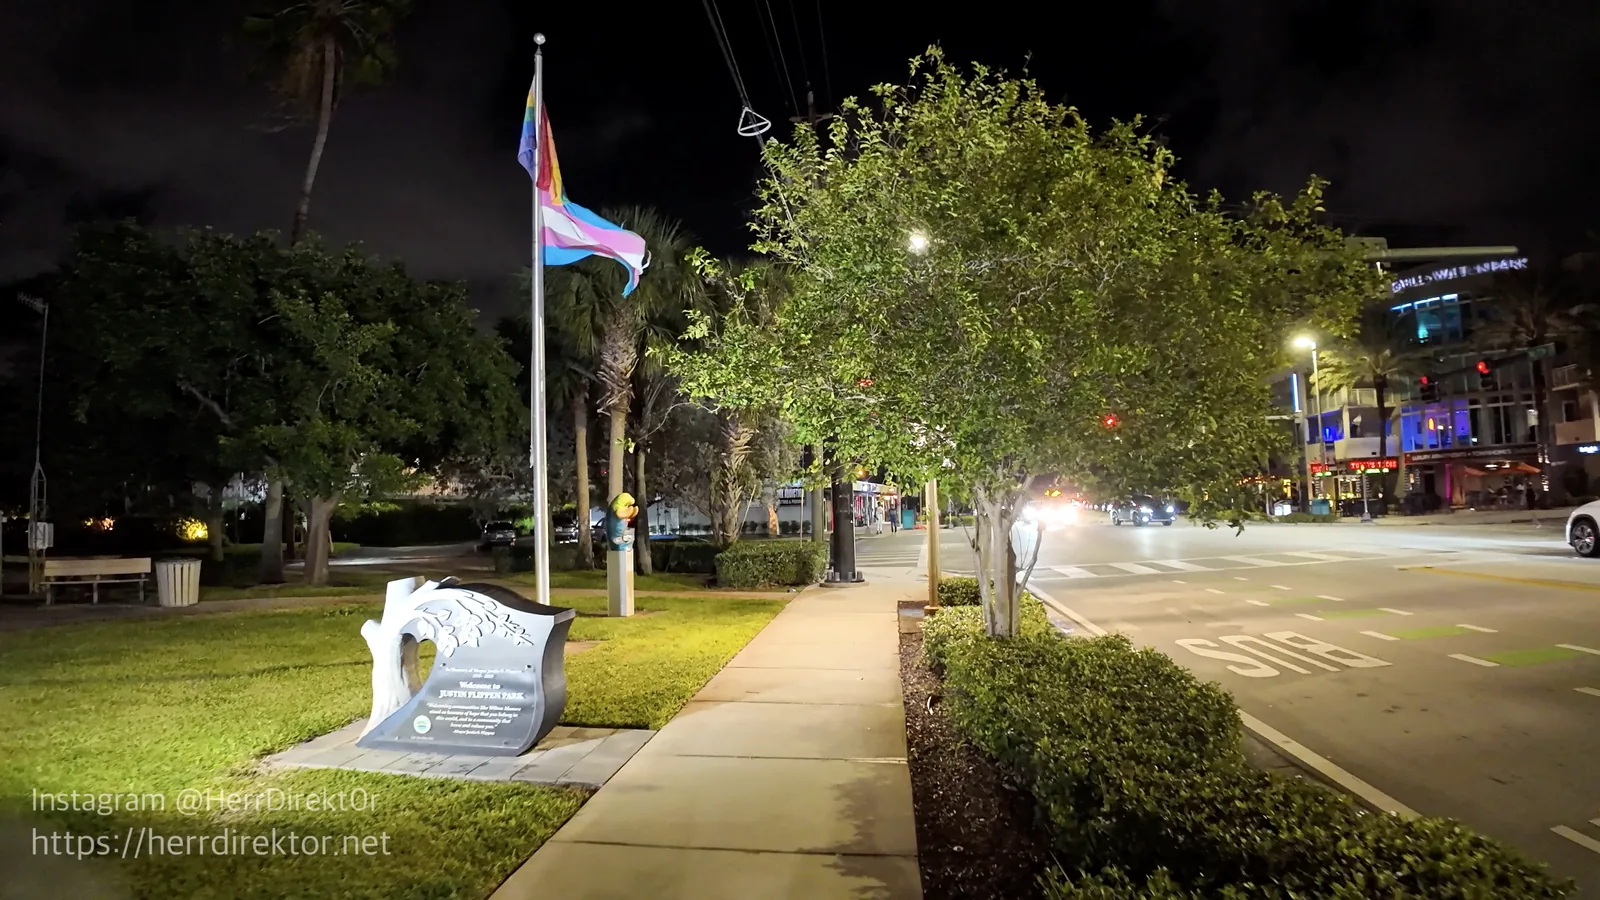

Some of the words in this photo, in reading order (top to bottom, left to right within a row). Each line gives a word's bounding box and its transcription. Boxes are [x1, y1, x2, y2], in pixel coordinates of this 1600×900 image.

[1432, 263, 1490, 281] WILTN
[1377, 459, 1397, 468] TCOS
[1175, 631, 1393, 677] BUS
[459, 681, 492, 690] Welcome
[438, 690, 466, 699] JUSTIN
[467, 691, 501, 700] FLIPPEN
[501, 692, 524, 700] PARK
